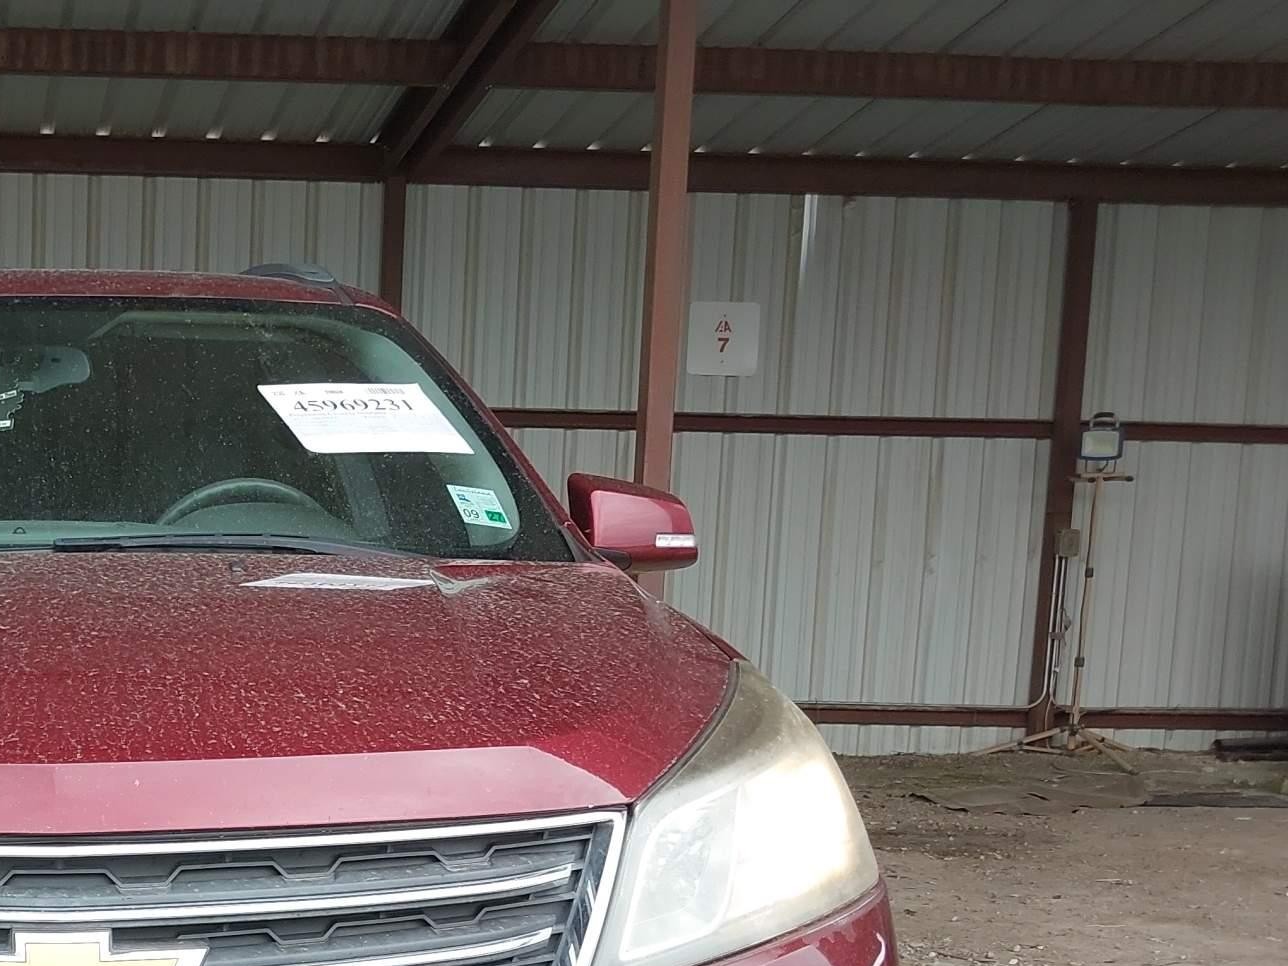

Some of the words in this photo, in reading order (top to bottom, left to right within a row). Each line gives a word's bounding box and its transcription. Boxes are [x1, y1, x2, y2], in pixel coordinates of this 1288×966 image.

[718, 337, 730, 353] 7
[293, 398, 414, 412] 45969231
[463, 508, 480, 519] 09
